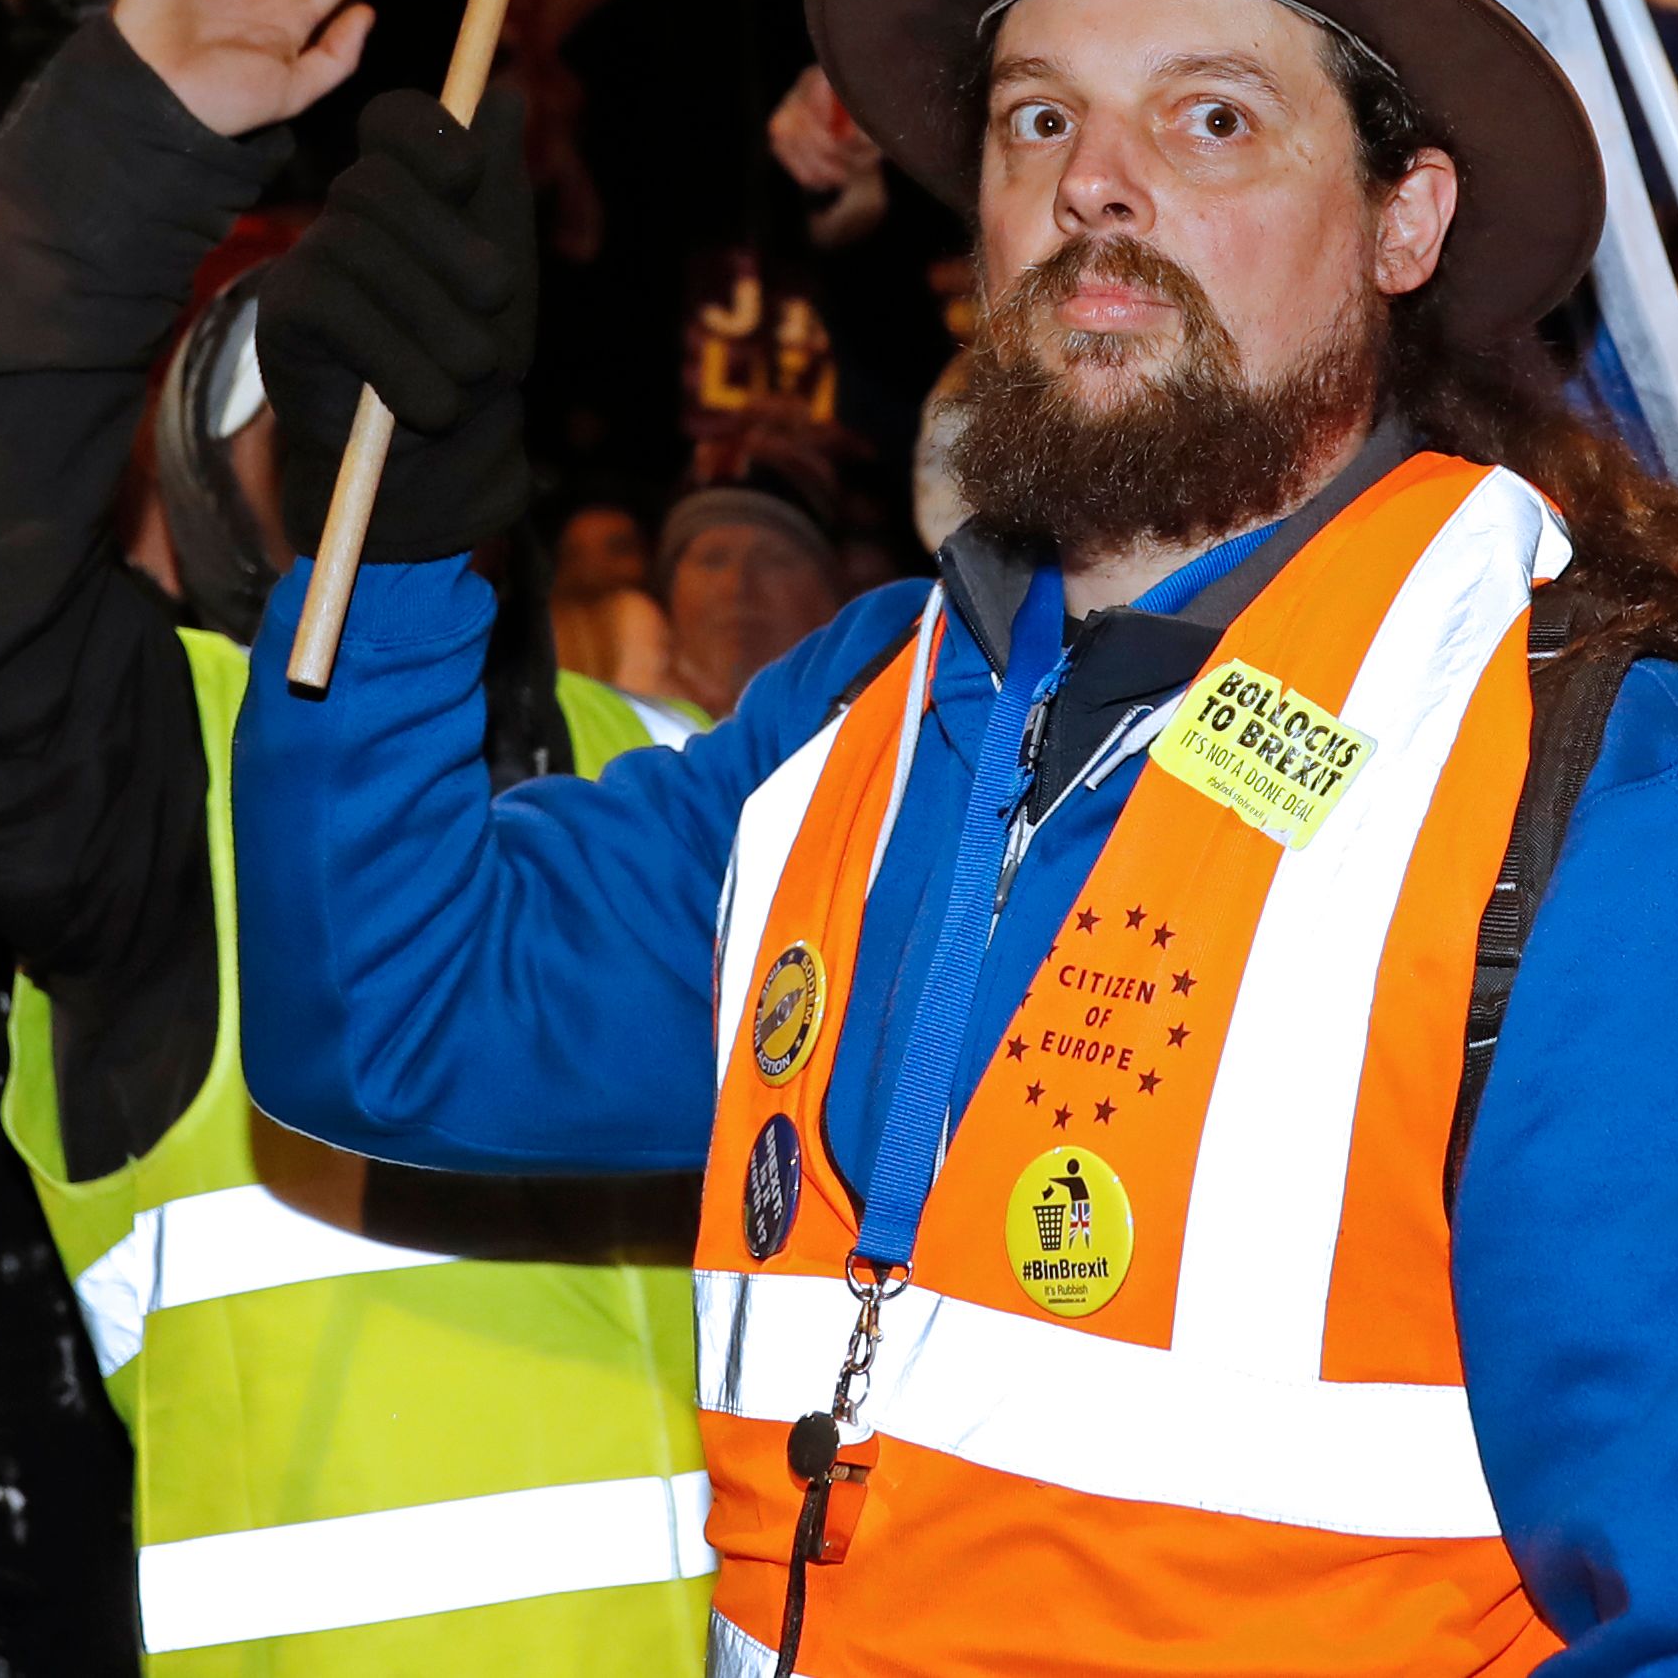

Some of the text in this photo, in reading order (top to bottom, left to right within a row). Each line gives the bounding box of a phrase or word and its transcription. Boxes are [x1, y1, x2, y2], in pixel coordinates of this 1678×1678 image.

[1216, 671, 1361, 768] BOLLOCKS
[1197, 695, 1343, 797] TO BREXIT
[1180, 730, 1315, 823] IT'S NOT A DONE DEAL
[1059, 965, 1156, 1005] CITIZEN
[1085, 1006, 1113, 1029] OF
[756, 1053, 792, 1074] ACTION
[1041, 1030, 1134, 1071] EUROPE
[1023, 1257, 1109, 1281] #BinBrexit
[1044, 1284, 1089, 1296] It's Rubbish
